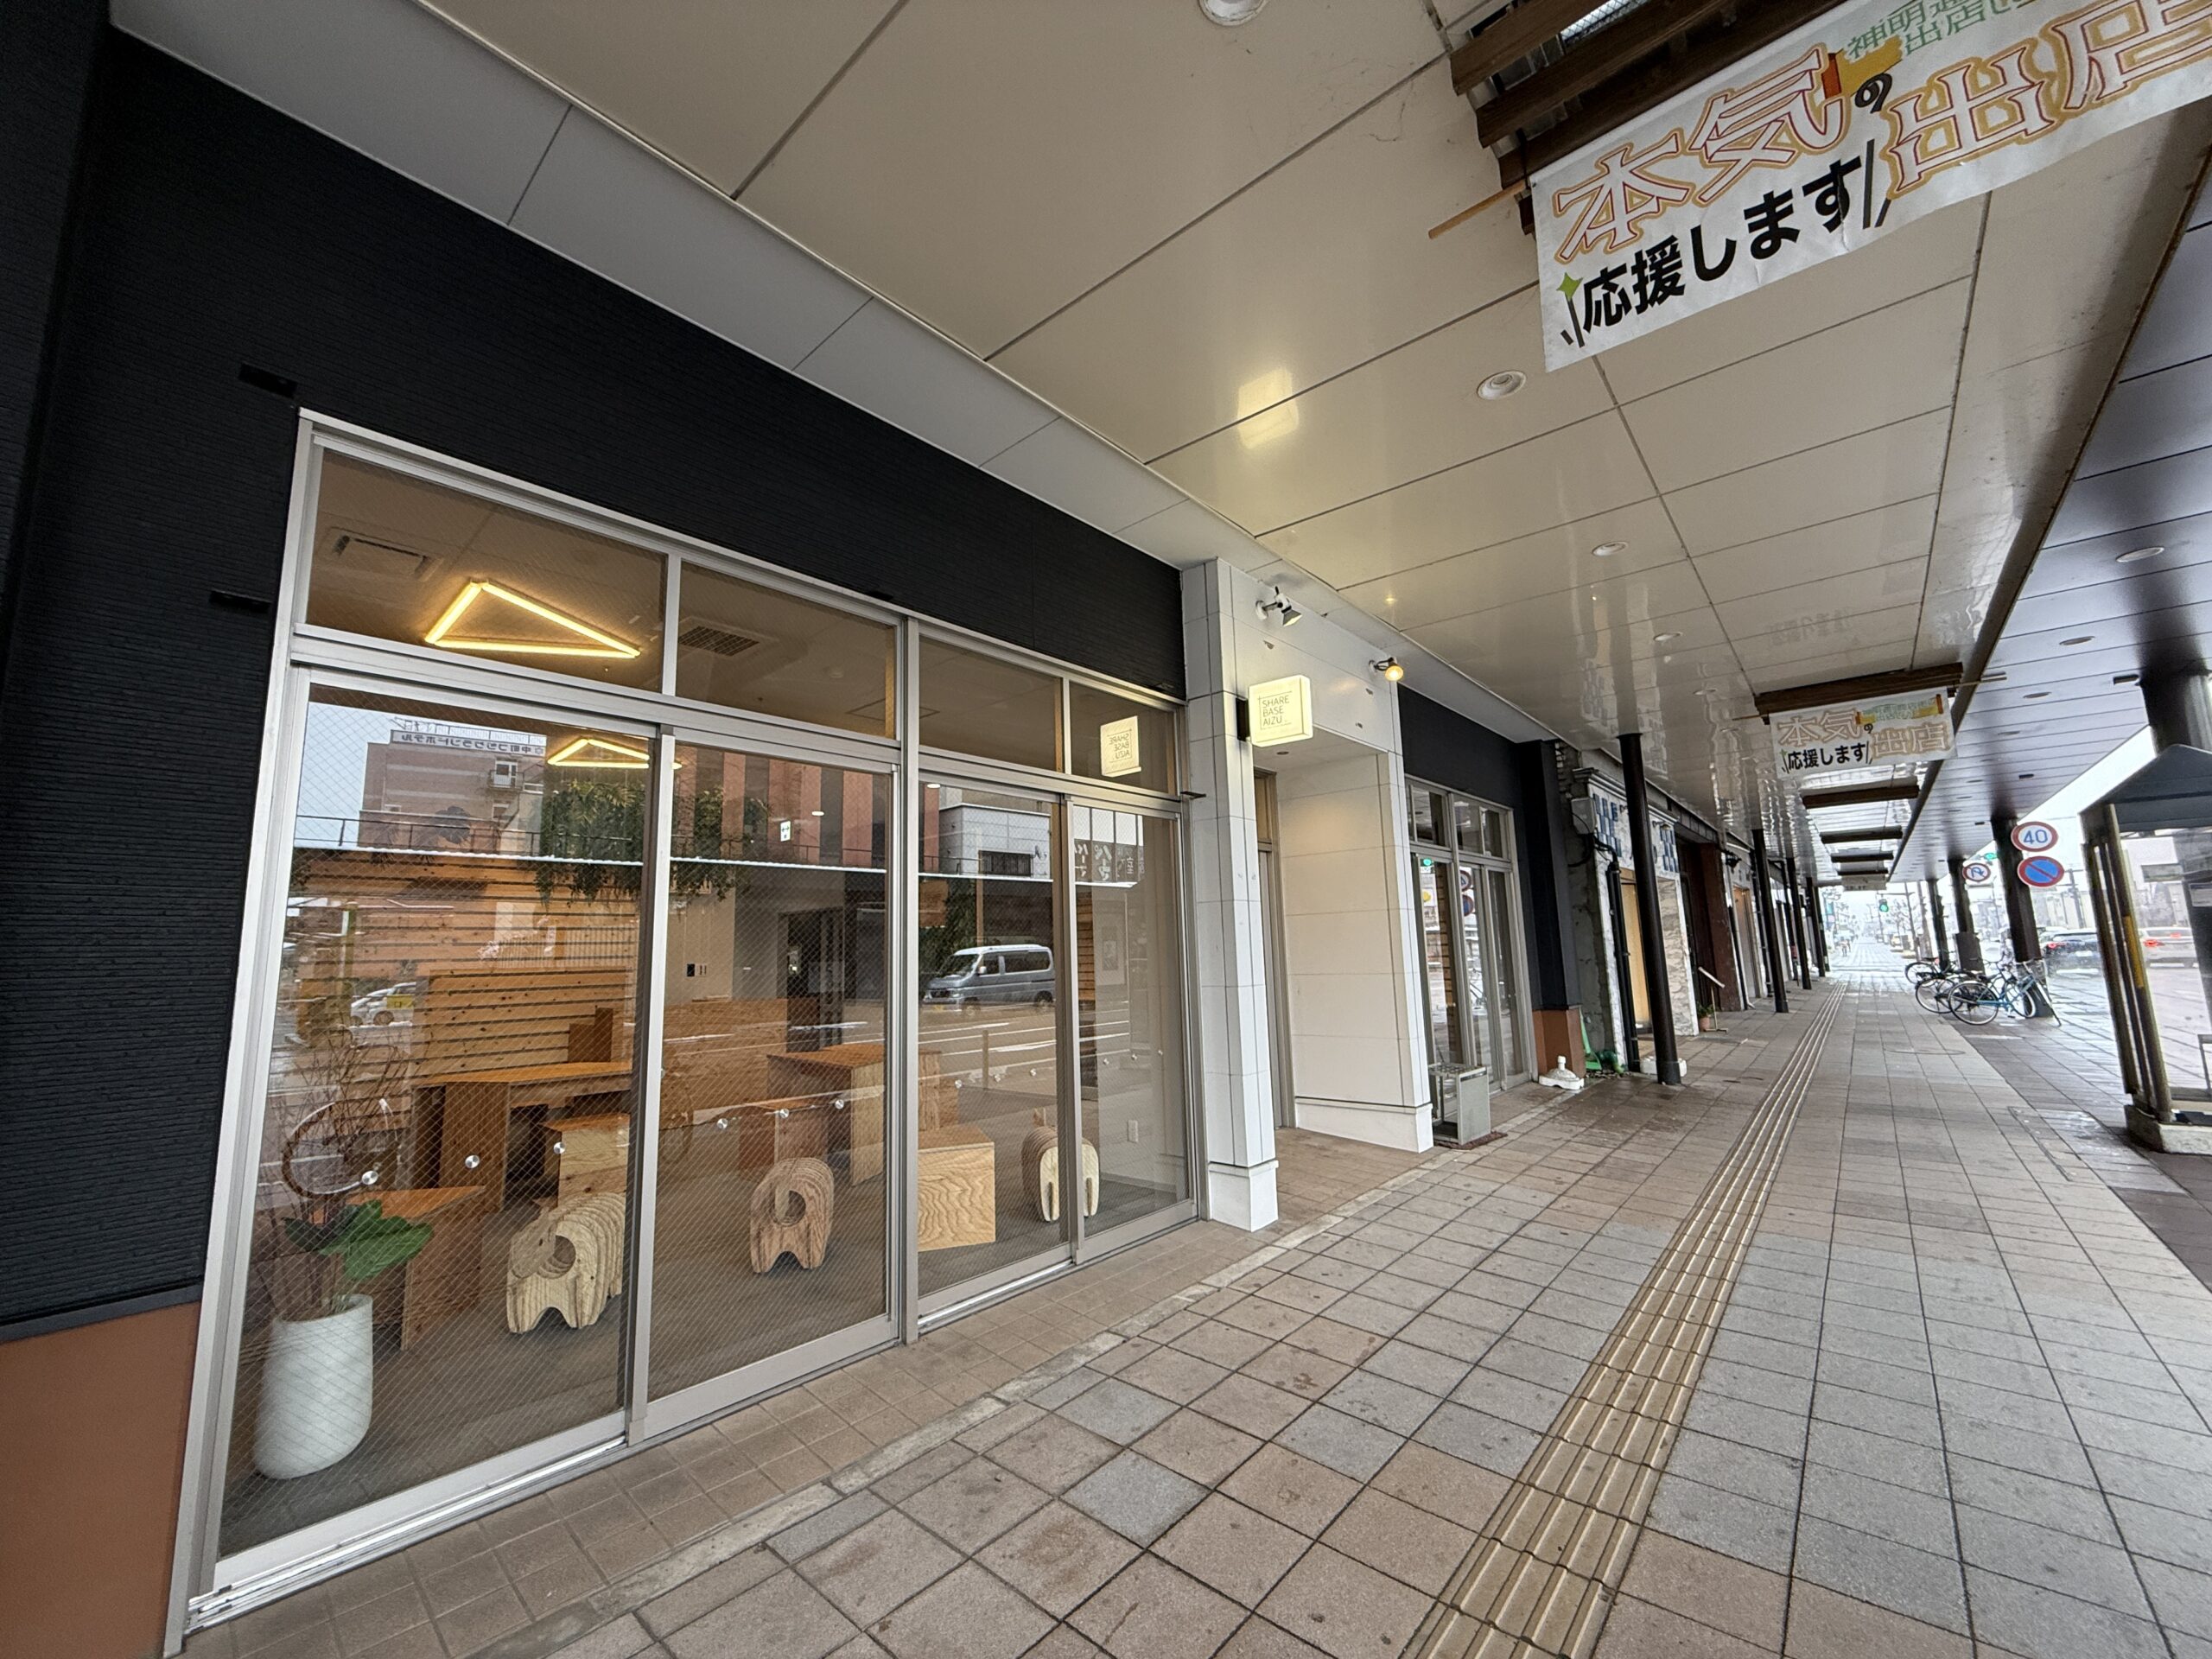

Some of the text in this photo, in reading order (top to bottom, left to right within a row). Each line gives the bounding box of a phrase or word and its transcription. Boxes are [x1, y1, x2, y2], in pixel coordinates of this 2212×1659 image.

[1583, 156, 1862, 333] 応援します
[1262, 695, 1290, 708] SHARE
[1262, 705, 1284, 717] BASE
[1788, 743, 1866, 770] 応援します
[2023, 830, 2049, 844] 40
